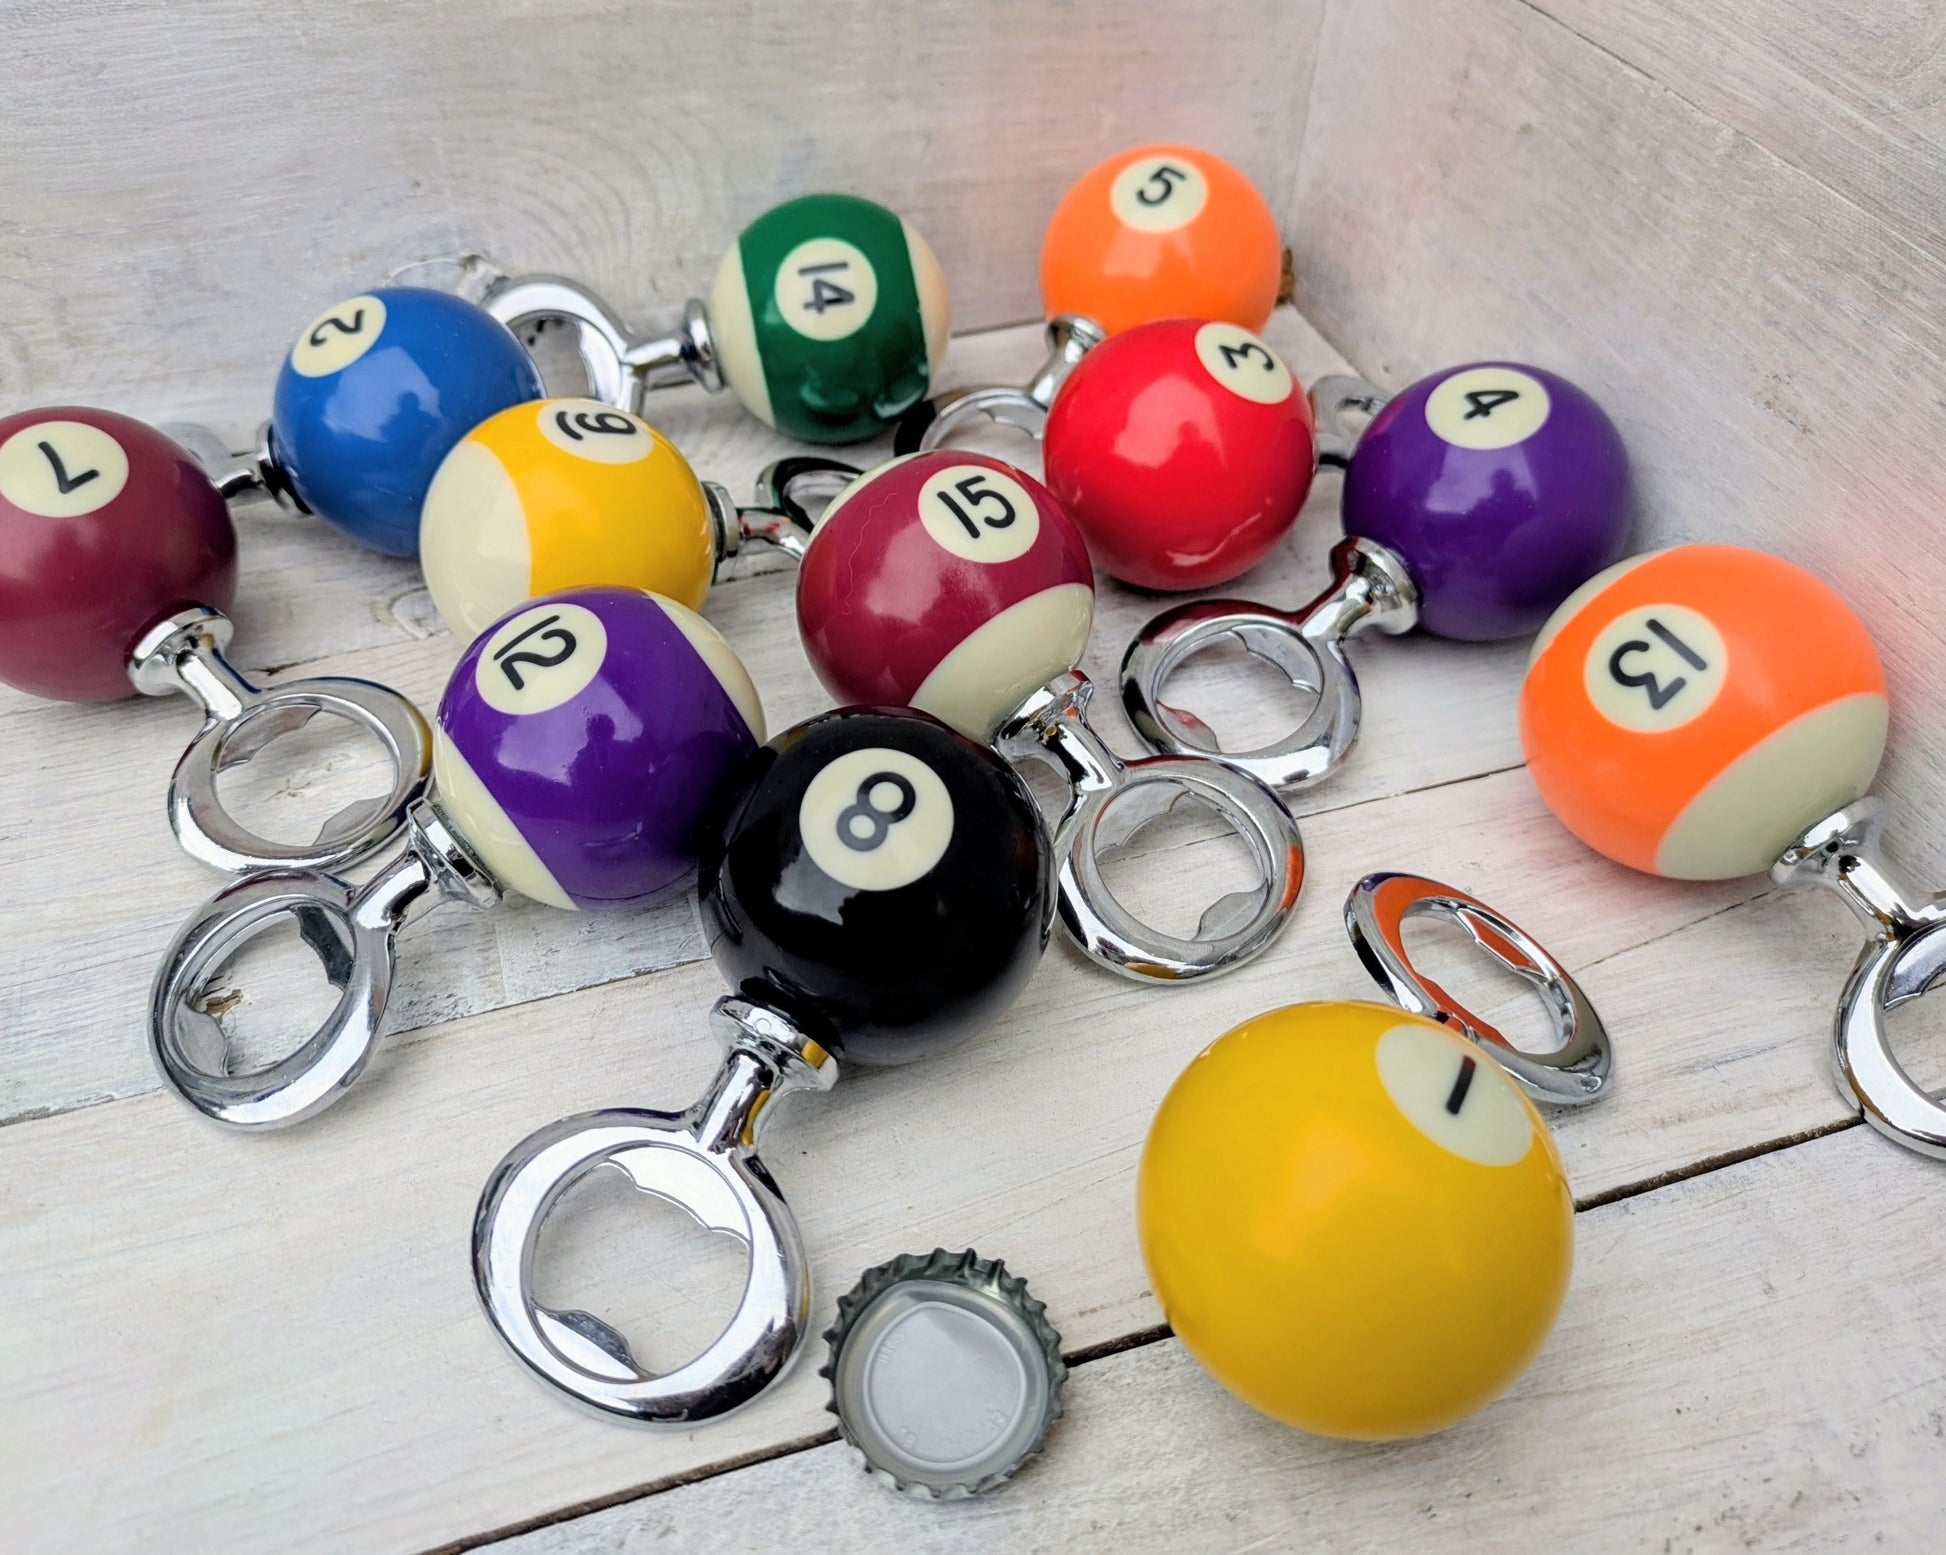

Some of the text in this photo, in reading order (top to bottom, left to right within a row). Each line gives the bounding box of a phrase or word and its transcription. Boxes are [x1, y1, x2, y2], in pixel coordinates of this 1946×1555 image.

[1136, 166, 1186, 207] 5
[798, 262, 855, 315] 14
[309, 309, 364, 347] 2
[1218, 342, 1275, 372] 3
[1463, 389, 1520, 420] 4
[37, 441, 100, 495] 7
[936, 475, 1016, 540] 15
[492, 614, 577, 691] 12
[1608, 619, 1707, 711] 13
[836, 771, 917, 852] 8
[1444, 1054, 1477, 1117] 1
